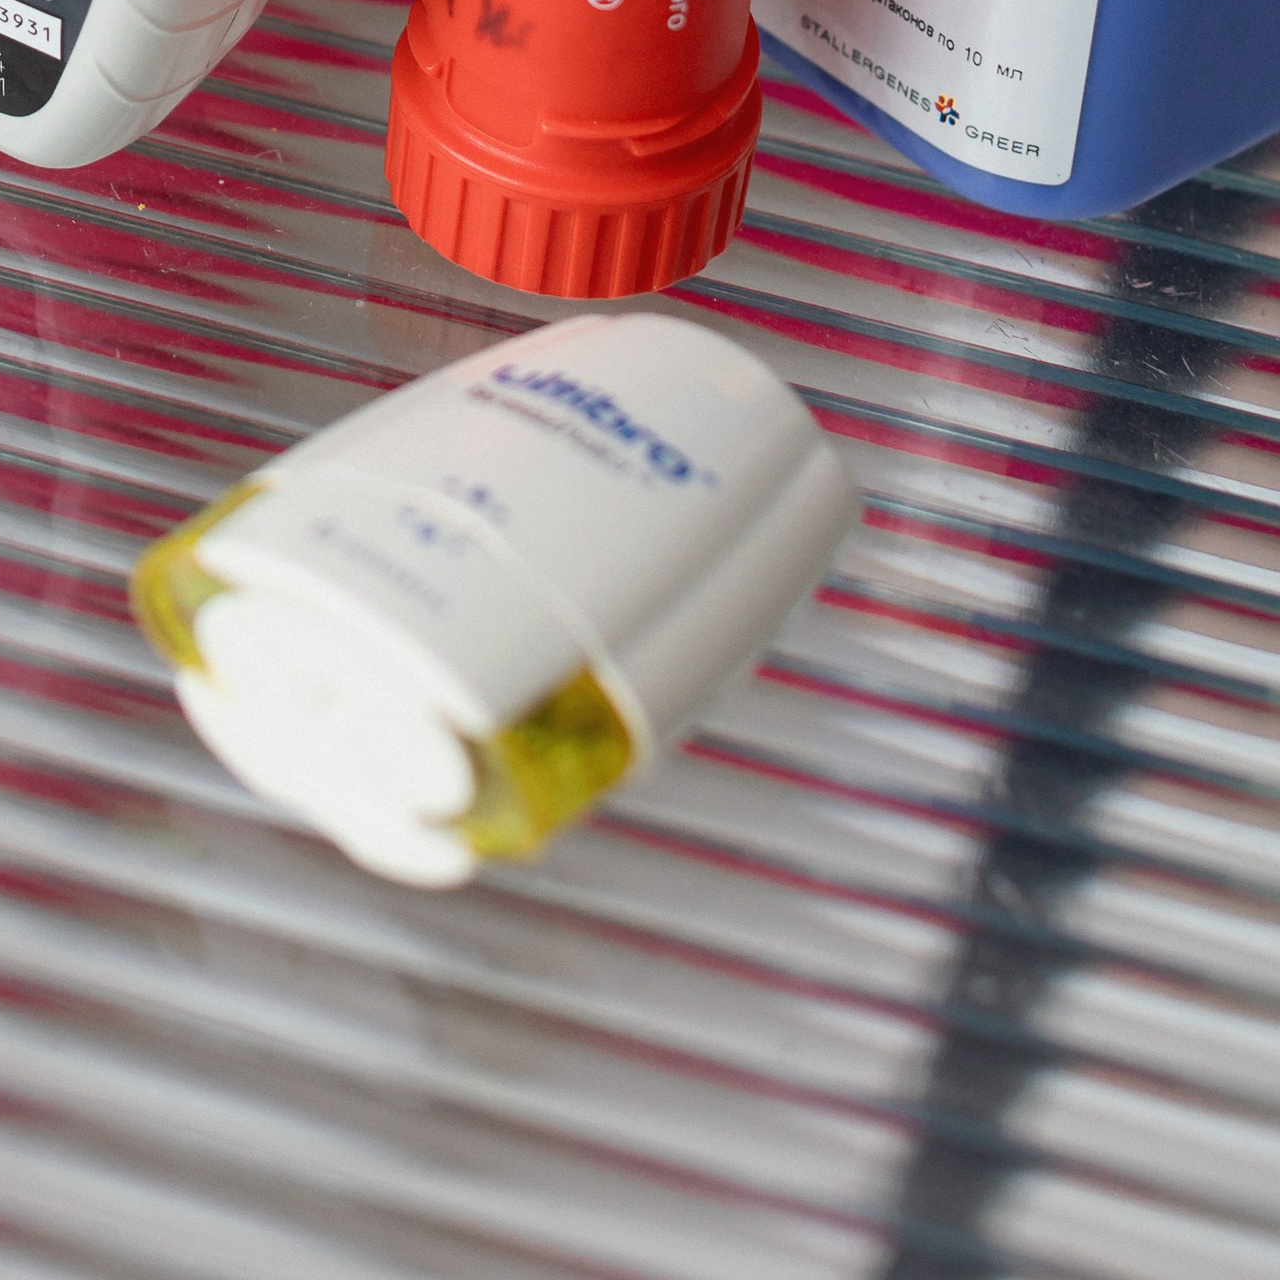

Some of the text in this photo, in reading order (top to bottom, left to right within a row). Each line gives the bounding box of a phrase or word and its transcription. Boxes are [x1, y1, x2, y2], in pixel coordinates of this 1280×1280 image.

[800, 13, 1040, 157] STALLERGENES GREER
[937, 32, 955, 51] по
[965, 47, 983, 67] 10
[996, 63, 1023, 81] мл
